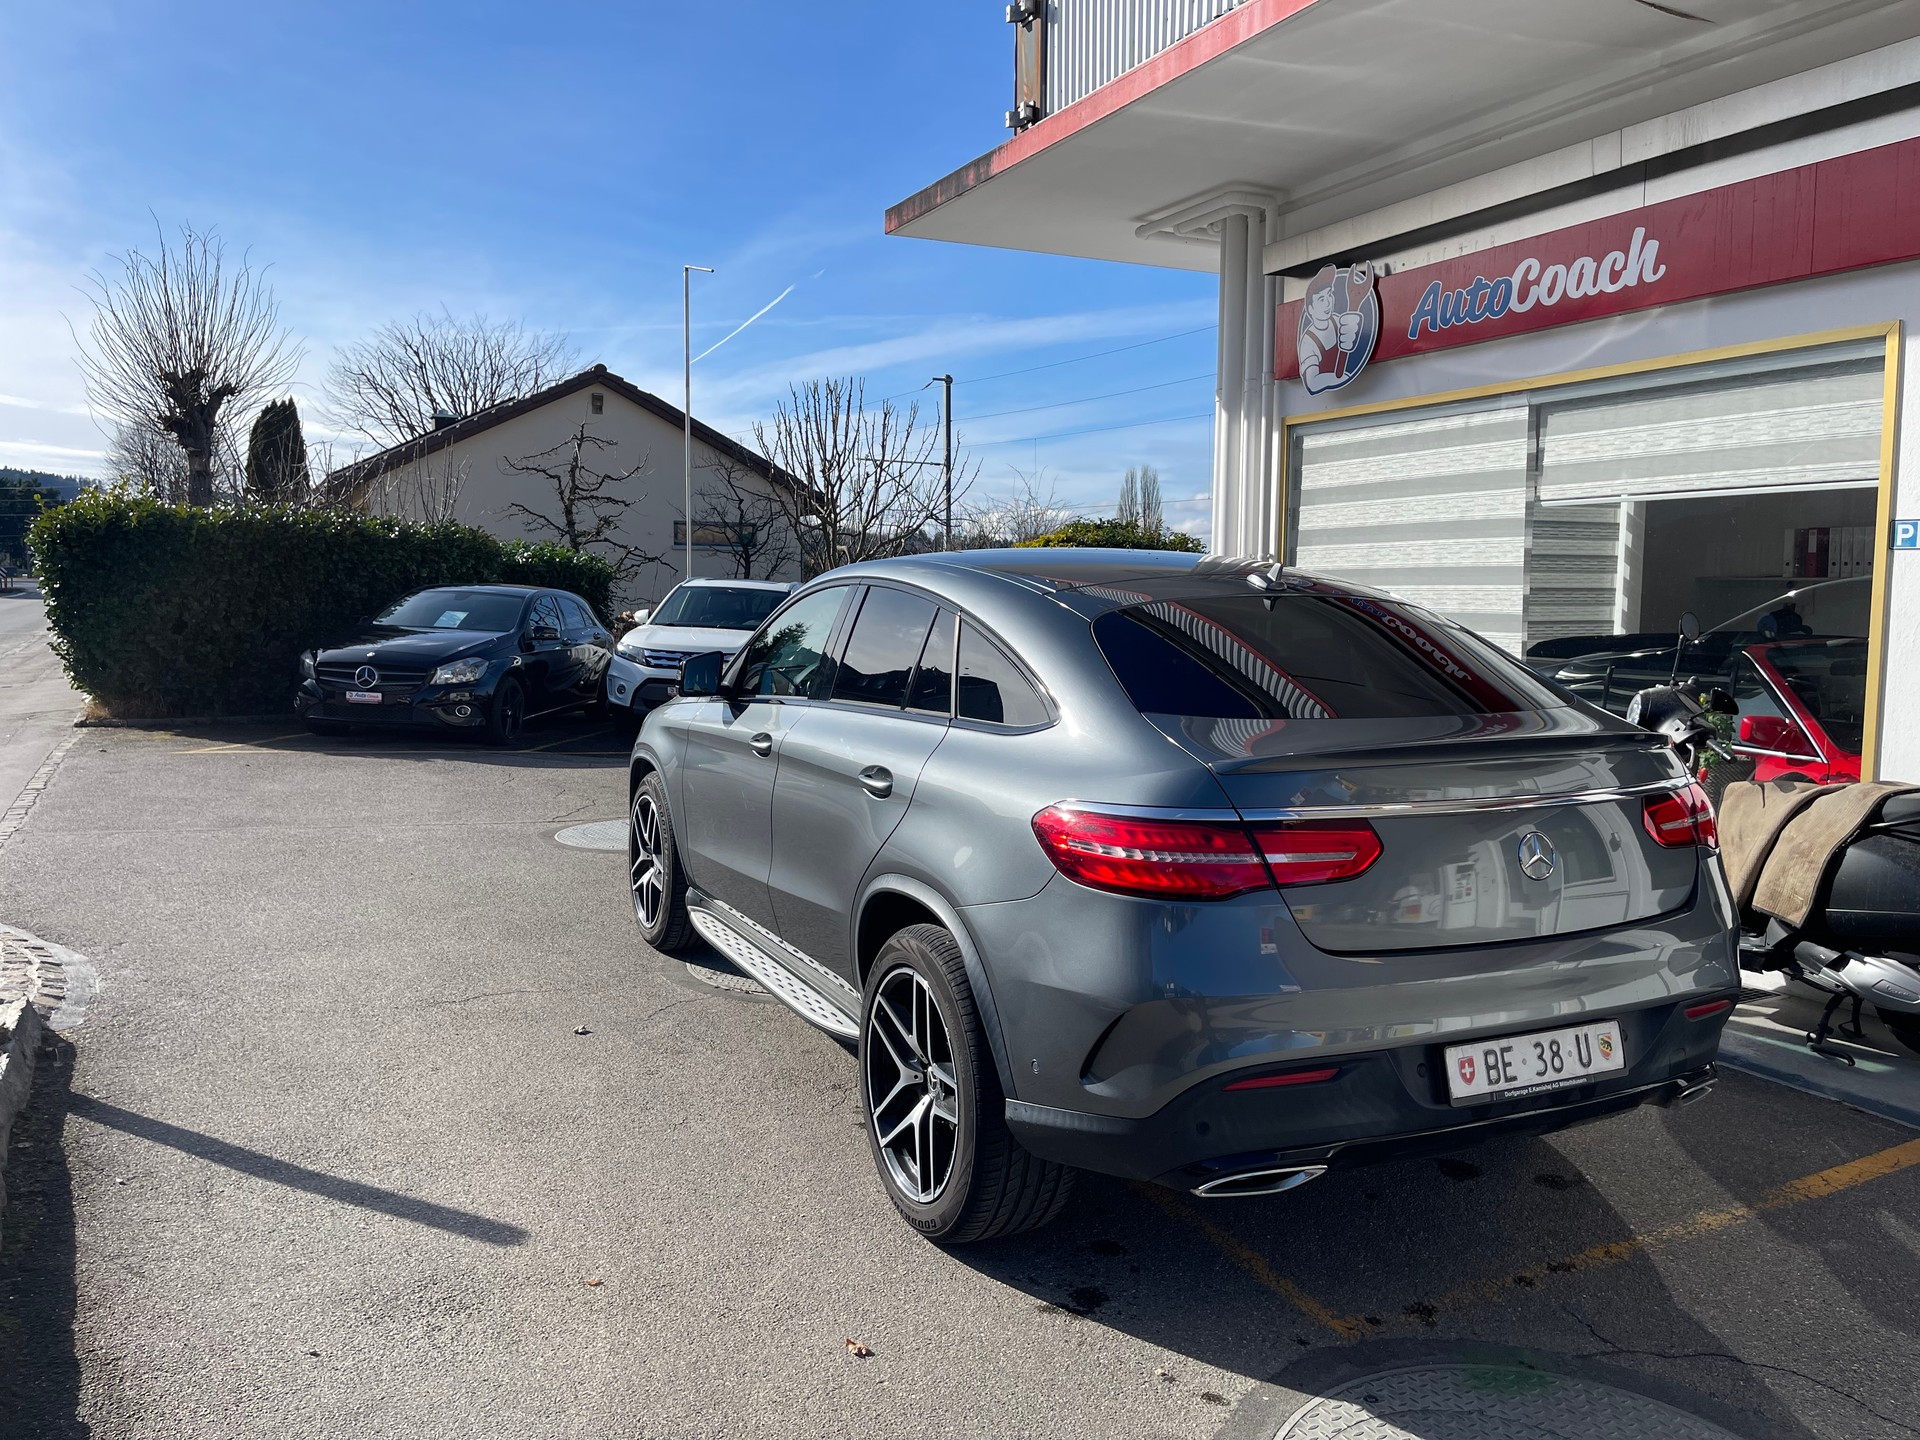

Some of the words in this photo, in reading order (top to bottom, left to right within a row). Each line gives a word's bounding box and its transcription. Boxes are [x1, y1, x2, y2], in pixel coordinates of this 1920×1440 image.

[1897, 524, 1915, 546] P
[1483, 1045, 1518, 1086] BE
[1533, 1039, 1564, 1077] 38
[1575, 1032, 1592, 1068] U
[1504, 1088, 1528, 1098] Dorfgarage
